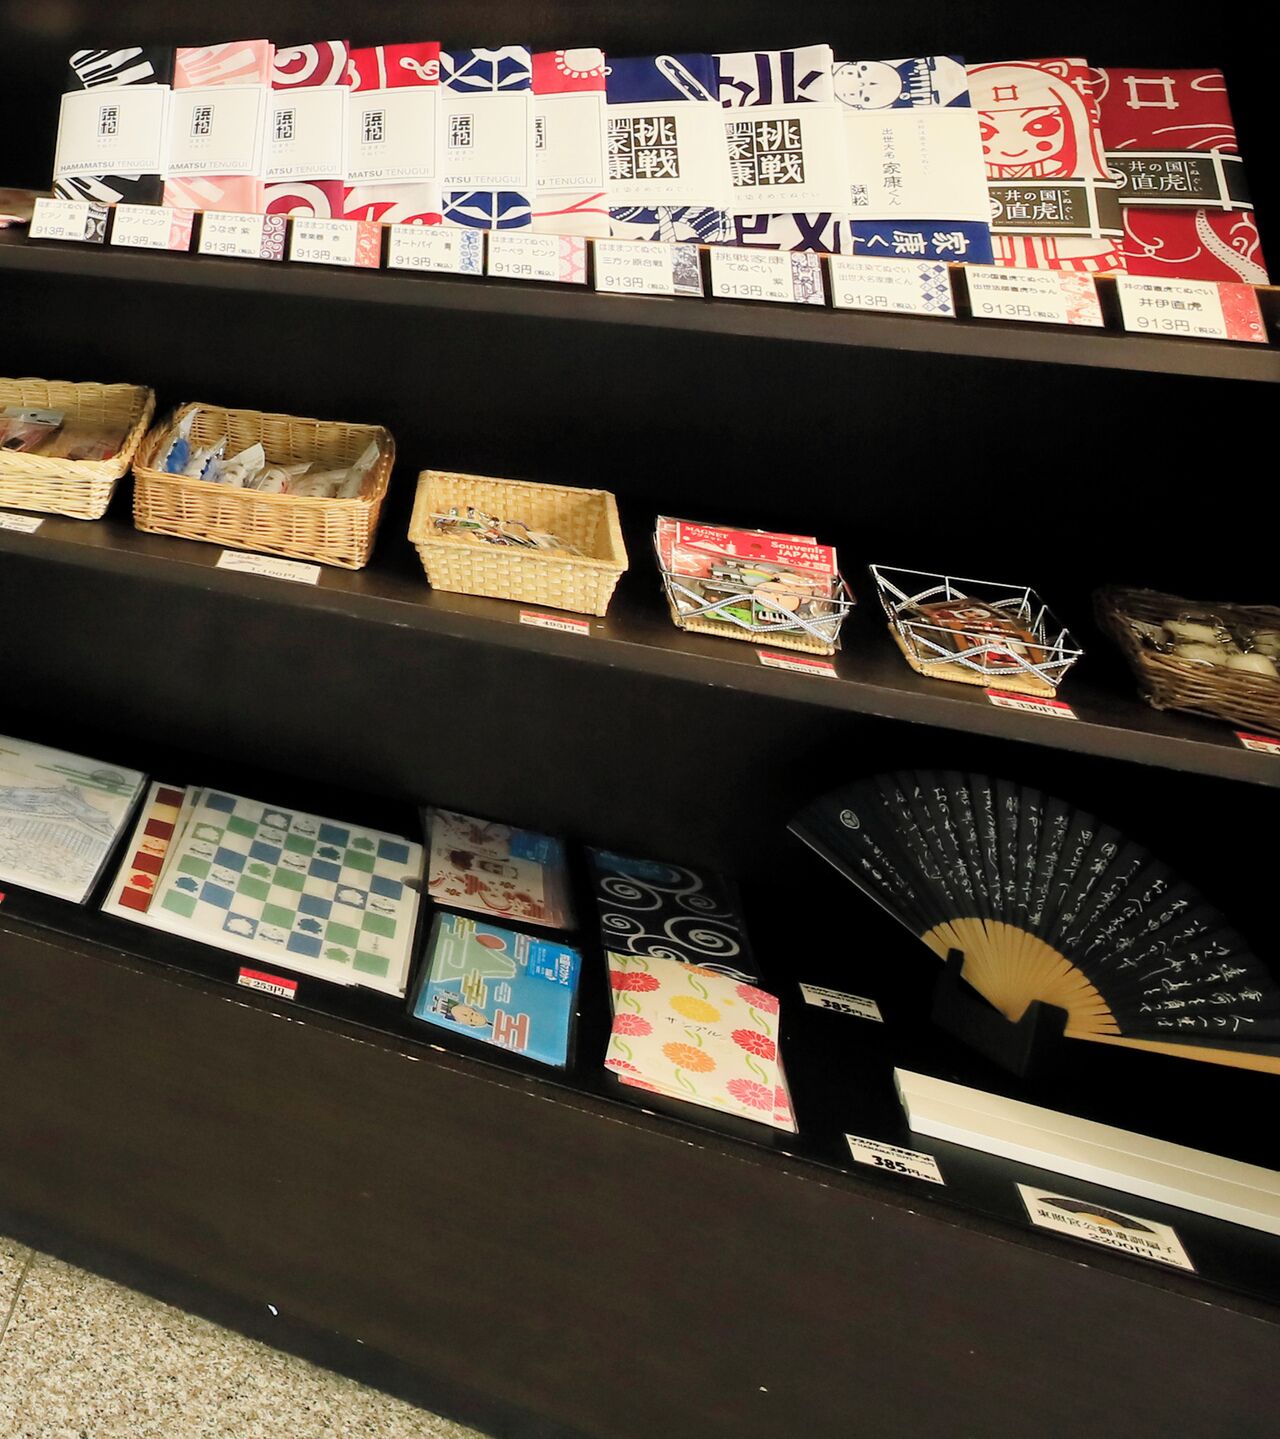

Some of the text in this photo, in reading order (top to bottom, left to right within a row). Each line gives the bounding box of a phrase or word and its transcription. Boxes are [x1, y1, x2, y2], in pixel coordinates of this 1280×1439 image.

[100, 107, 118, 135] 浜松
[194, 107, 212, 135] 浜松
[276, 110, 293, 139] 浜松
[363, 111, 383, 141] 浜松
[451, 116, 472, 146] 浜松
[634, 118, 679, 177] 挑戦
[757, 120, 804, 184] 挑戦
[60, 160, 154, 172] HAMAMATSU TENUGUI
[209, 161, 248, 169] TENUGUI
[295, 164, 337, 173] TENUGUI
[1129, 161, 1183, 172] 井の国
[348, 167, 429, 179] MATSU TENUGUI
[473, 175, 521, 184] TENUGUI
[1188, 161, 1202, 191] てぬぐい
[549, 177, 597, 186] TENUGUI
[1131, 173, 1187, 191] 直虎
[852, 184, 868, 206] 浜松
[1004, 189, 1057, 201] 井の国
[1006, 201, 1058, 220] 直虎
[1062, 190, 1074, 220] てぬぐい
[35, 226, 64, 236] 913円
[208, 224, 236, 234] うなぎ
[119, 235, 148, 246] 913円
[205, 241, 236, 253] 913円
[393, 239, 432, 249] オートバイ
[296, 247, 331, 260] 913円
[492, 246, 557, 258] ガーベラ ピンク
[598, 242, 667, 254] はままつてぬぐい
[395, 255, 431, 267] 913円
[495, 261, 532, 275] 913円
[725, 263, 774, 274] てぬぐい
[605, 275, 645, 288] 913円
[972, 272, 1056, 285] 井の国直虎てぬぐい
[720, 283, 763, 297] 913円
[1123, 283, 1215, 296] 井の国直虎てぬぐい
[844, 293, 888, 307] 913円
[1139, 297, 1204, 312] 井伊直虎
[982, 303, 1032, 317] 913円
[1136, 317, 1190, 332] 913円
[684, 525, 729, 540] MAGNET
[770, 541, 825, 555] Souvenir
[776, 549, 819, 562] JAPAN
